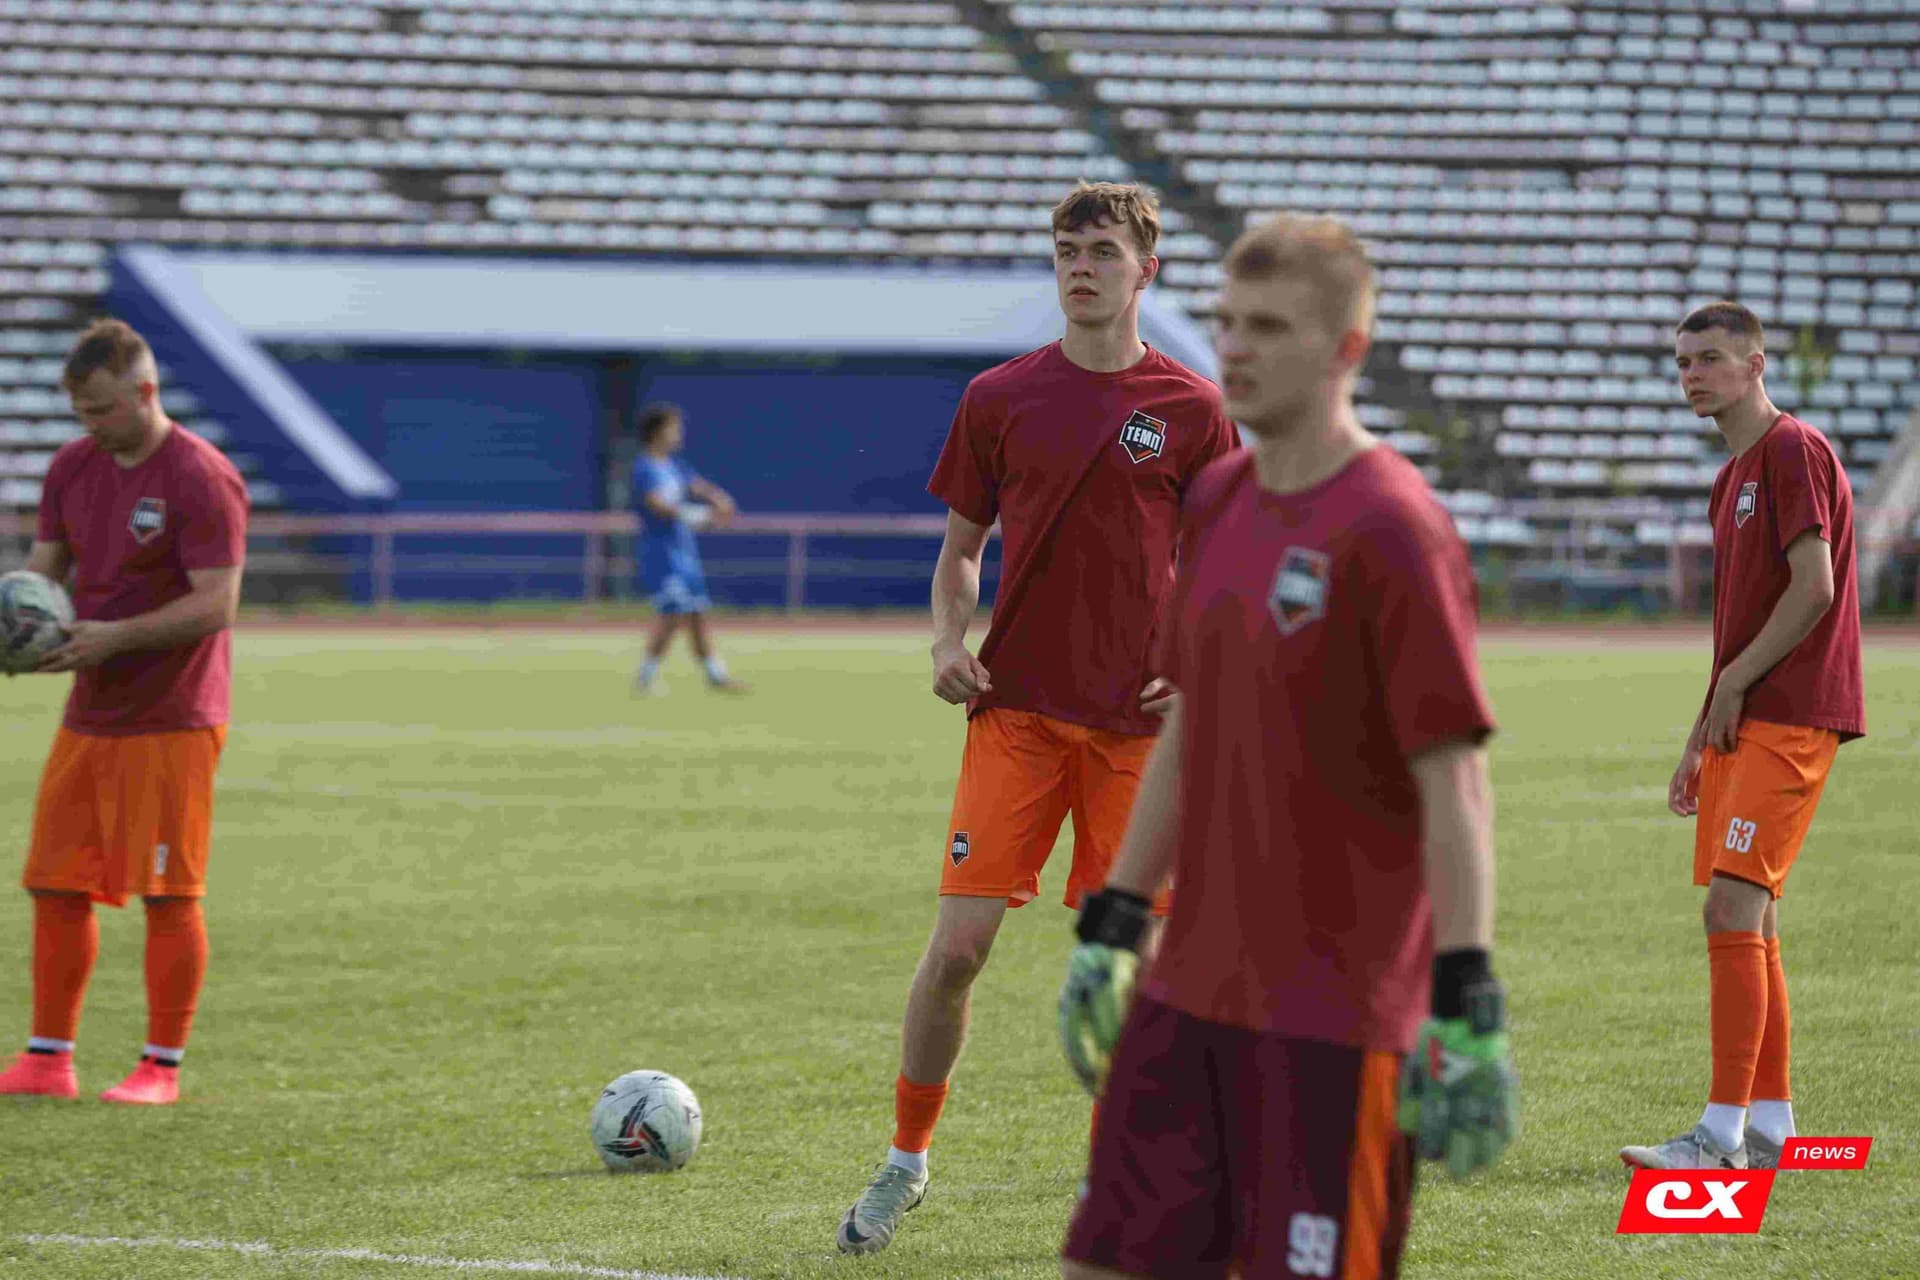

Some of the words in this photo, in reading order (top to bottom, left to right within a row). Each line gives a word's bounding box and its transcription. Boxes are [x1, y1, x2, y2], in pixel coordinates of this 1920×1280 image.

[1126, 426, 1161, 451] ТЕМП
[1725, 817, 1756, 853] 63
[1288, 1212, 1337, 1277] 99
